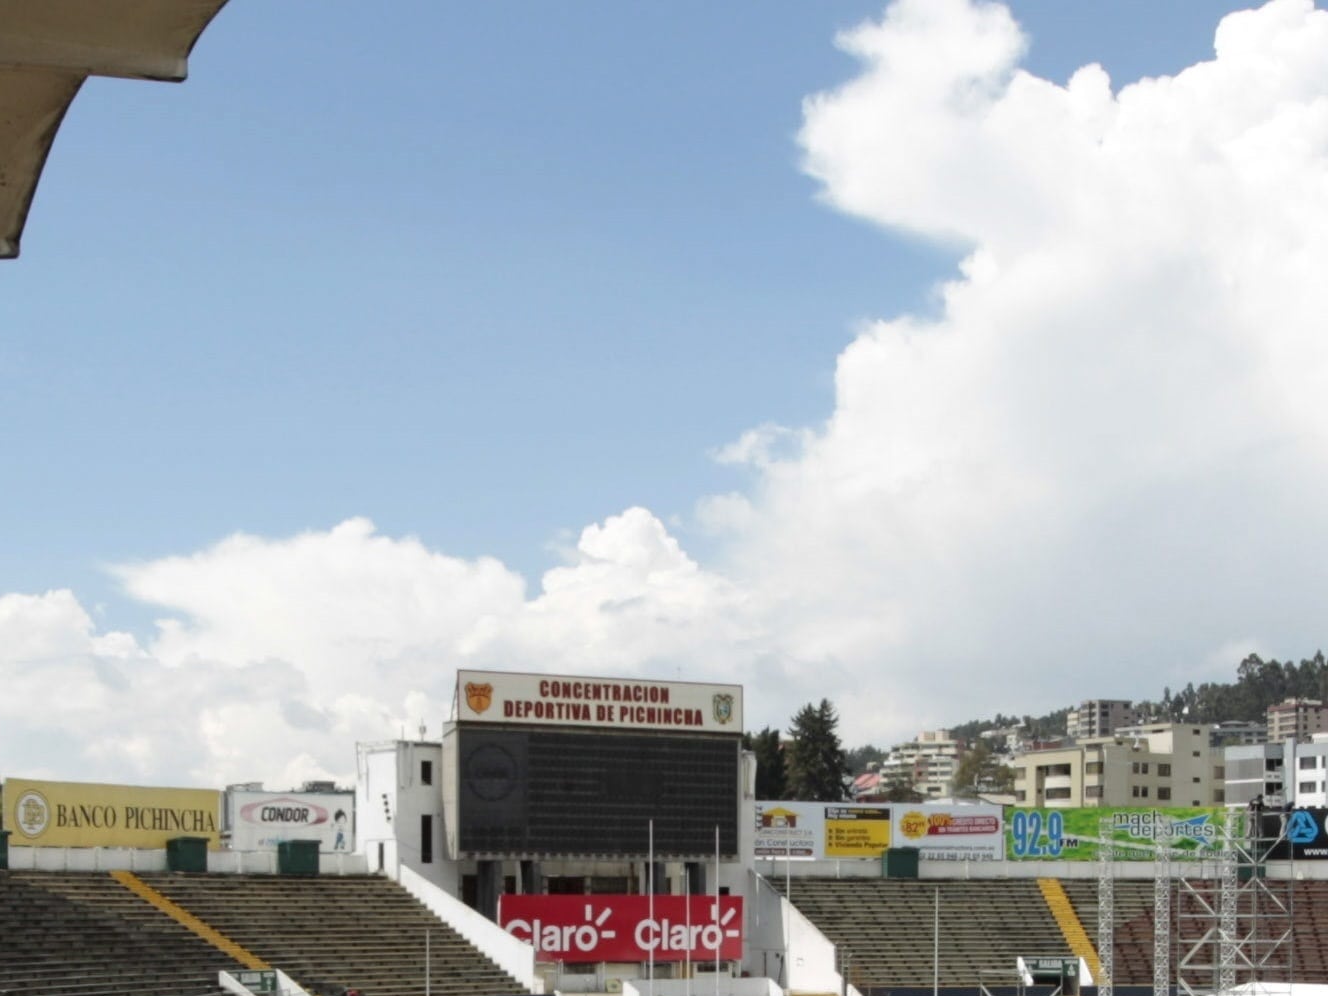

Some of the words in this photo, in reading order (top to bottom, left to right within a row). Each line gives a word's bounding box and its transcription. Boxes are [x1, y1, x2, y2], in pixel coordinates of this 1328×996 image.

[539, 680, 670, 704] CONCENTRACION
[503, 700, 591, 721] DEPORTIVA
[596, 705, 615, 722] DE
[620, 706, 703, 726] PICHINCHA
[56, 804, 117, 828] BANCO
[125, 806, 216, 832] PICHINCHA
[261, 807, 309, 822] CONDOR
[1013, 811, 1062, 855] 92.9
[1060, 839, 1078, 847] FM
[505, 919, 598, 951] Claro
[635, 919, 723, 950] Claro
